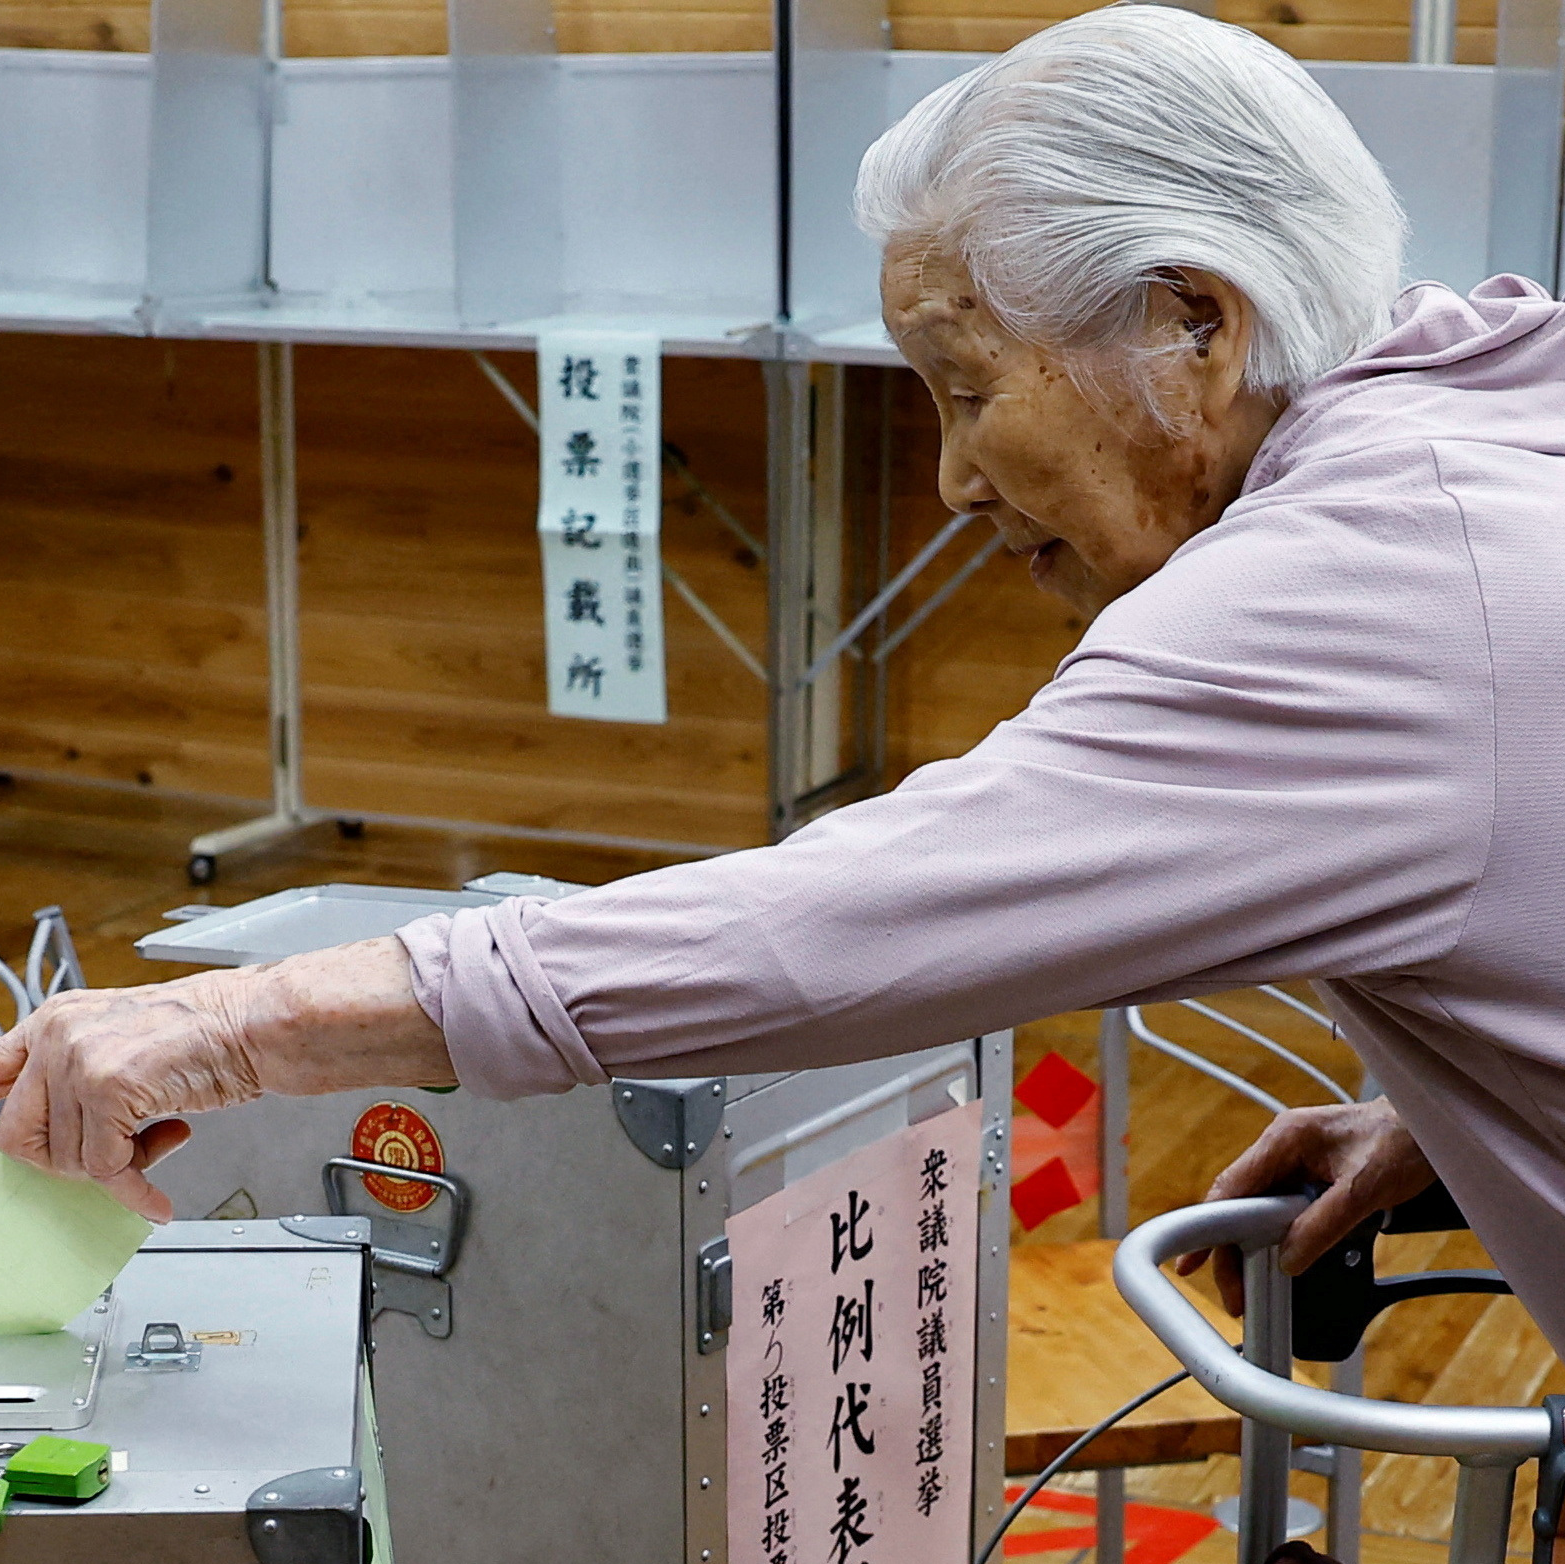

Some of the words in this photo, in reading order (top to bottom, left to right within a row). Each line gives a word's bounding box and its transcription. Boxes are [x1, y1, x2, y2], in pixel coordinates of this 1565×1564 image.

[559, 353, 605, 698] 投票記載所
[914, 1147, 949, 1517] 衆議院議員選挙
